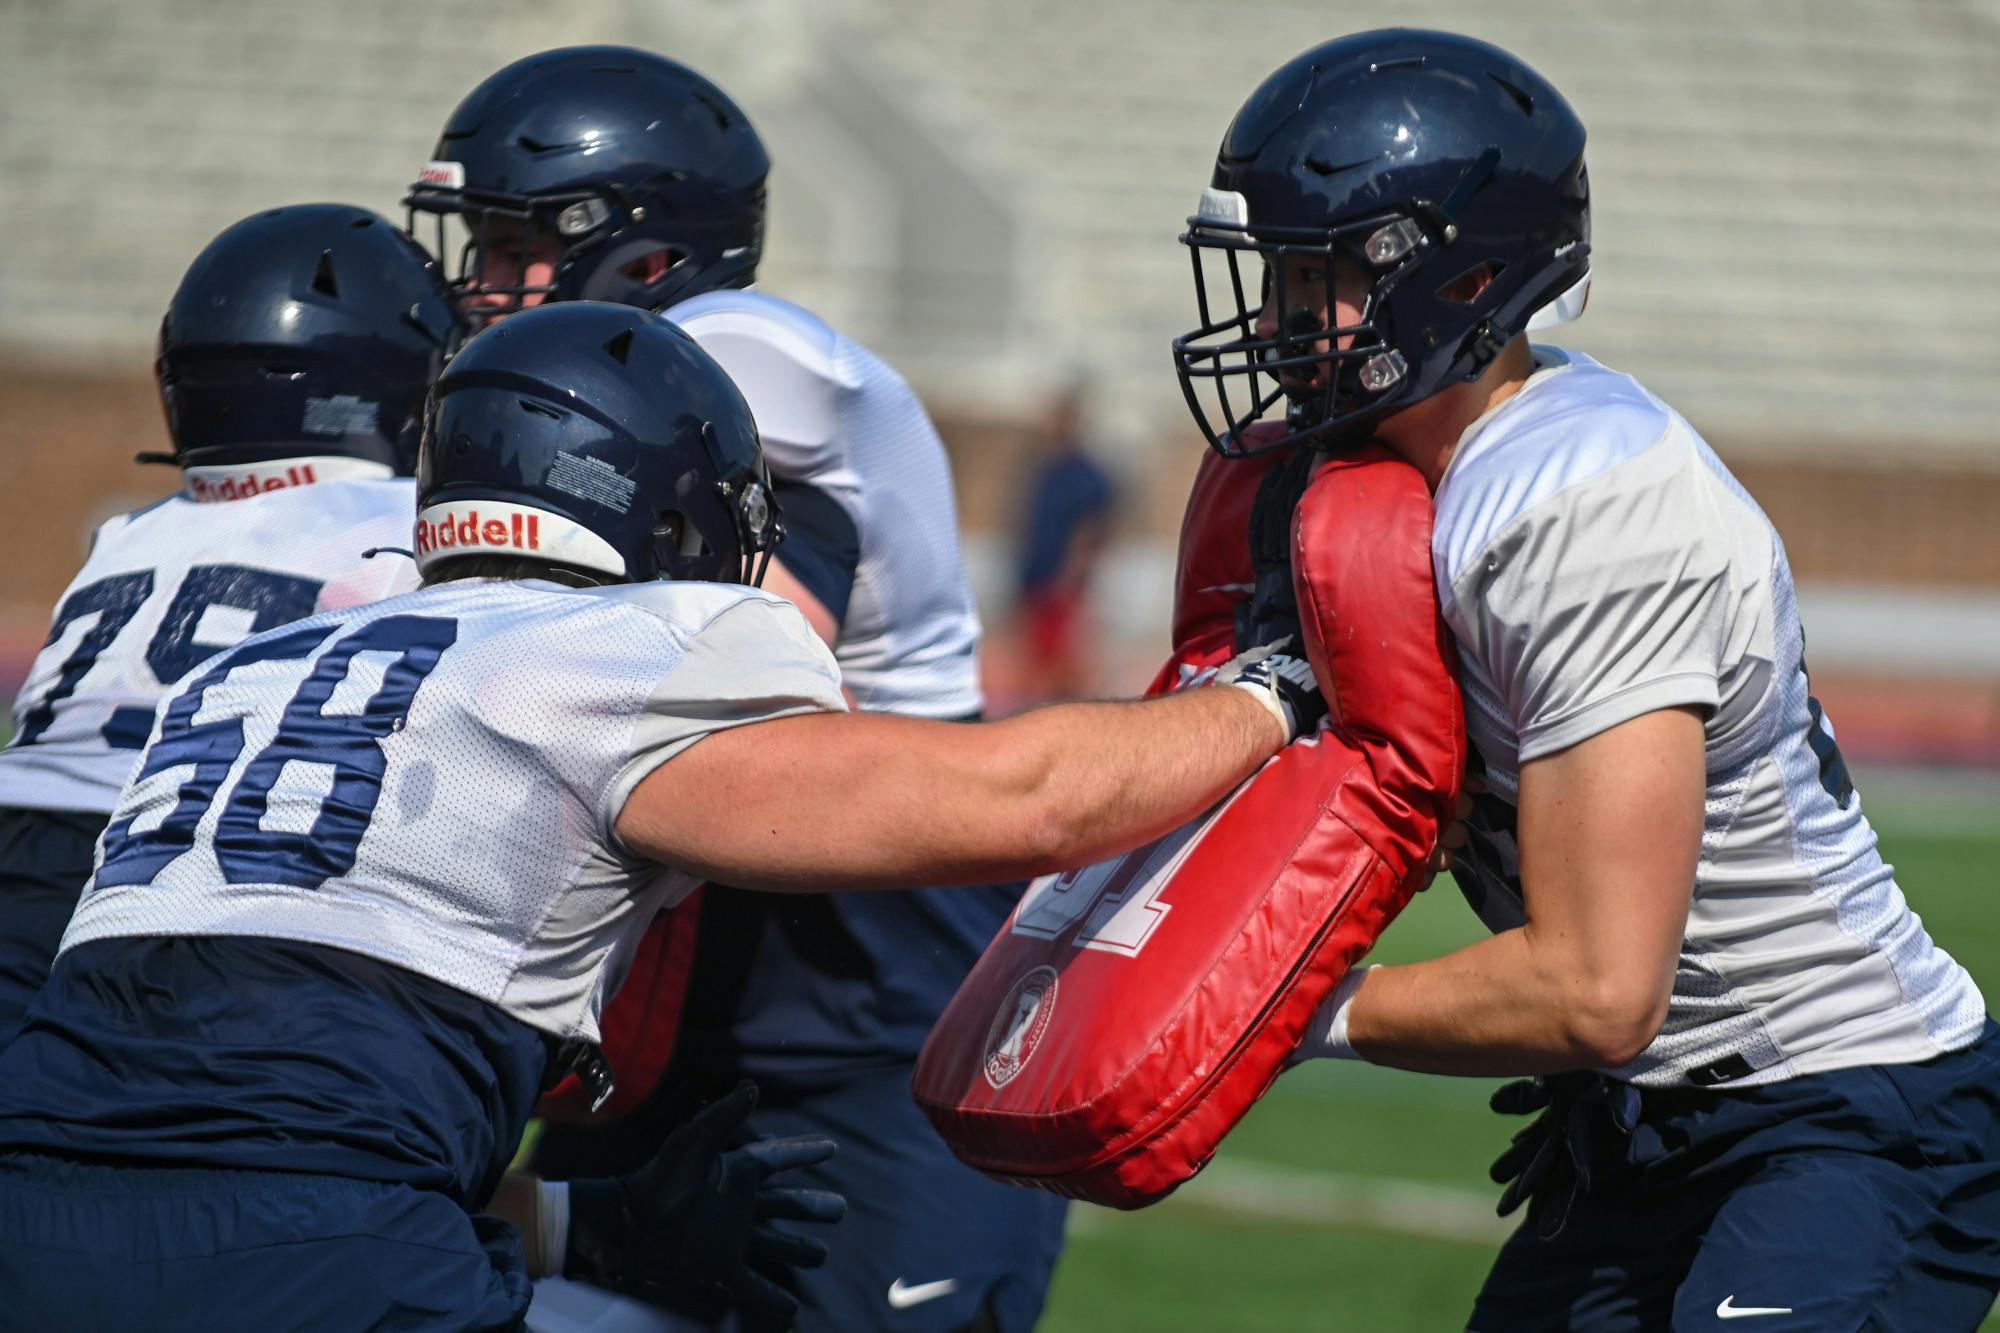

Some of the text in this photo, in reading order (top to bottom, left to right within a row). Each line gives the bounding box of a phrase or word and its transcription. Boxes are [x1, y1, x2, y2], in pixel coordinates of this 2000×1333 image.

[586, 454, 616, 471] WARNING
[417, 510, 539, 557] Riddell
[94, 614, 458, 890] 58
